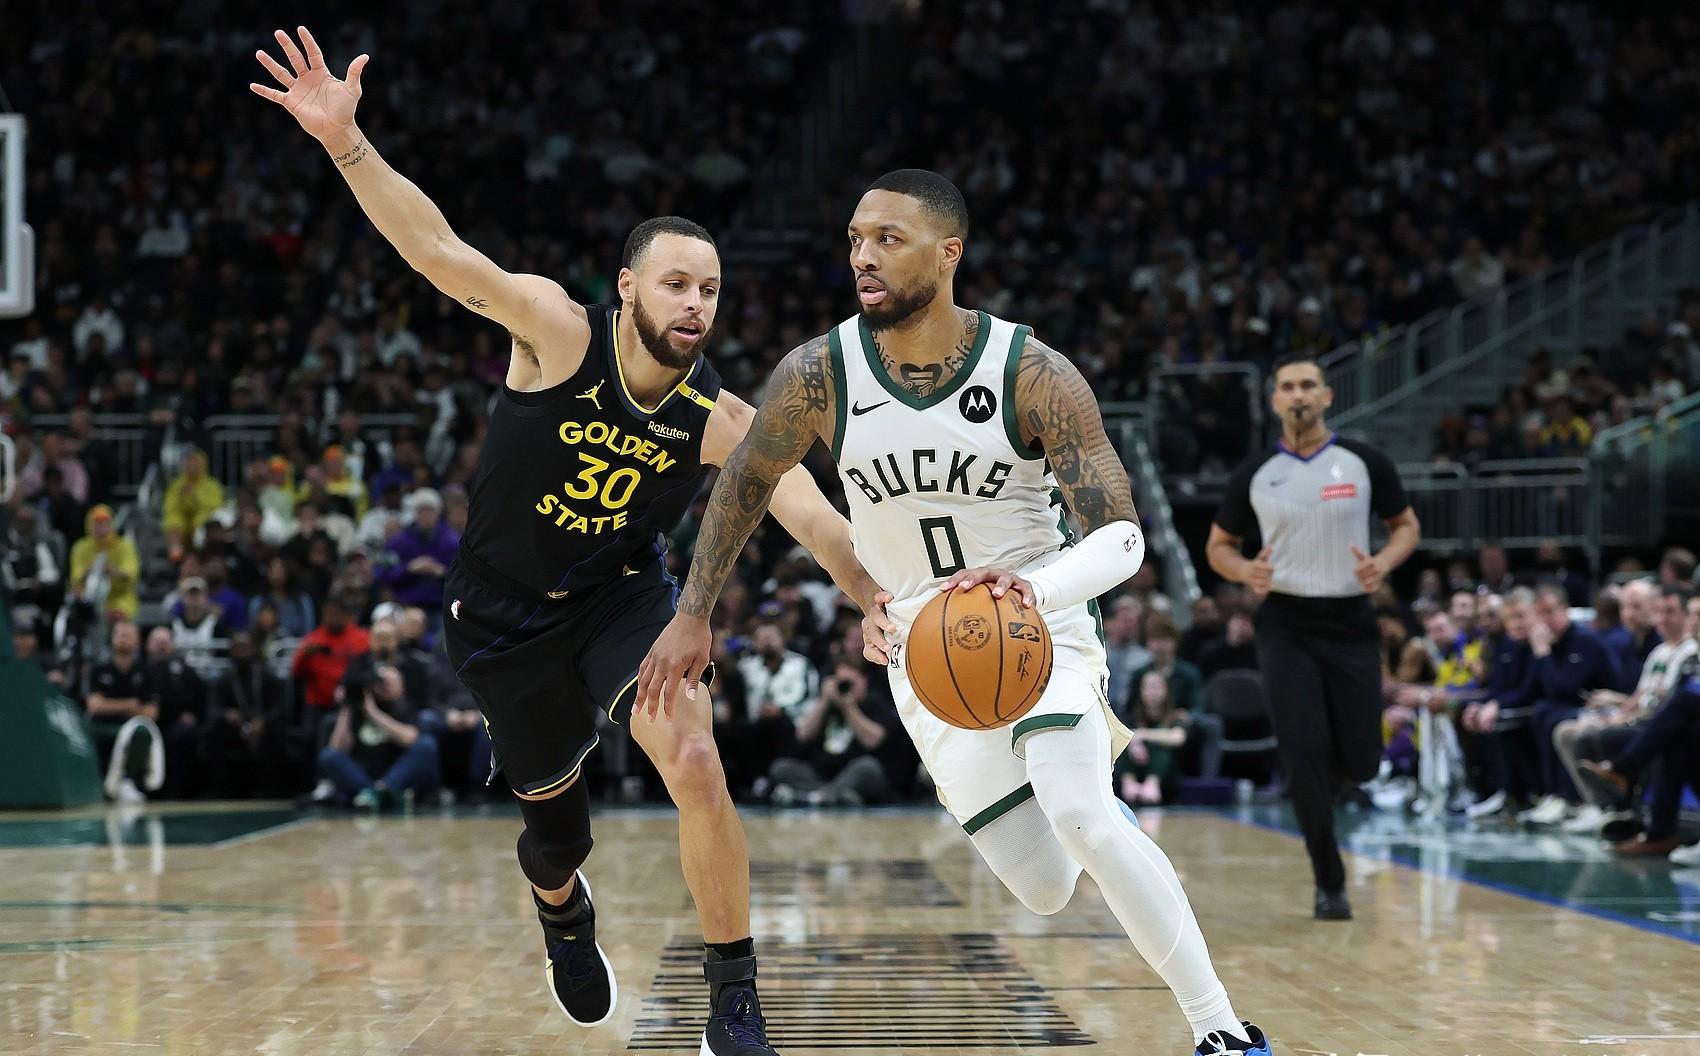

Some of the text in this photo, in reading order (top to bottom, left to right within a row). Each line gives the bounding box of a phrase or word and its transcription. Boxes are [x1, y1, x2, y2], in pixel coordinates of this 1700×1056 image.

[688, 390, 700, 401] 16
[558, 421, 677, 474] GOLDEN
[647, 420, 690, 441] Rakuten
[564, 451, 641, 510] 30
[845, 448, 1015, 505] BUCKS
[535, 493, 629, 535] STATE
[918, 514, 967, 580] 0
